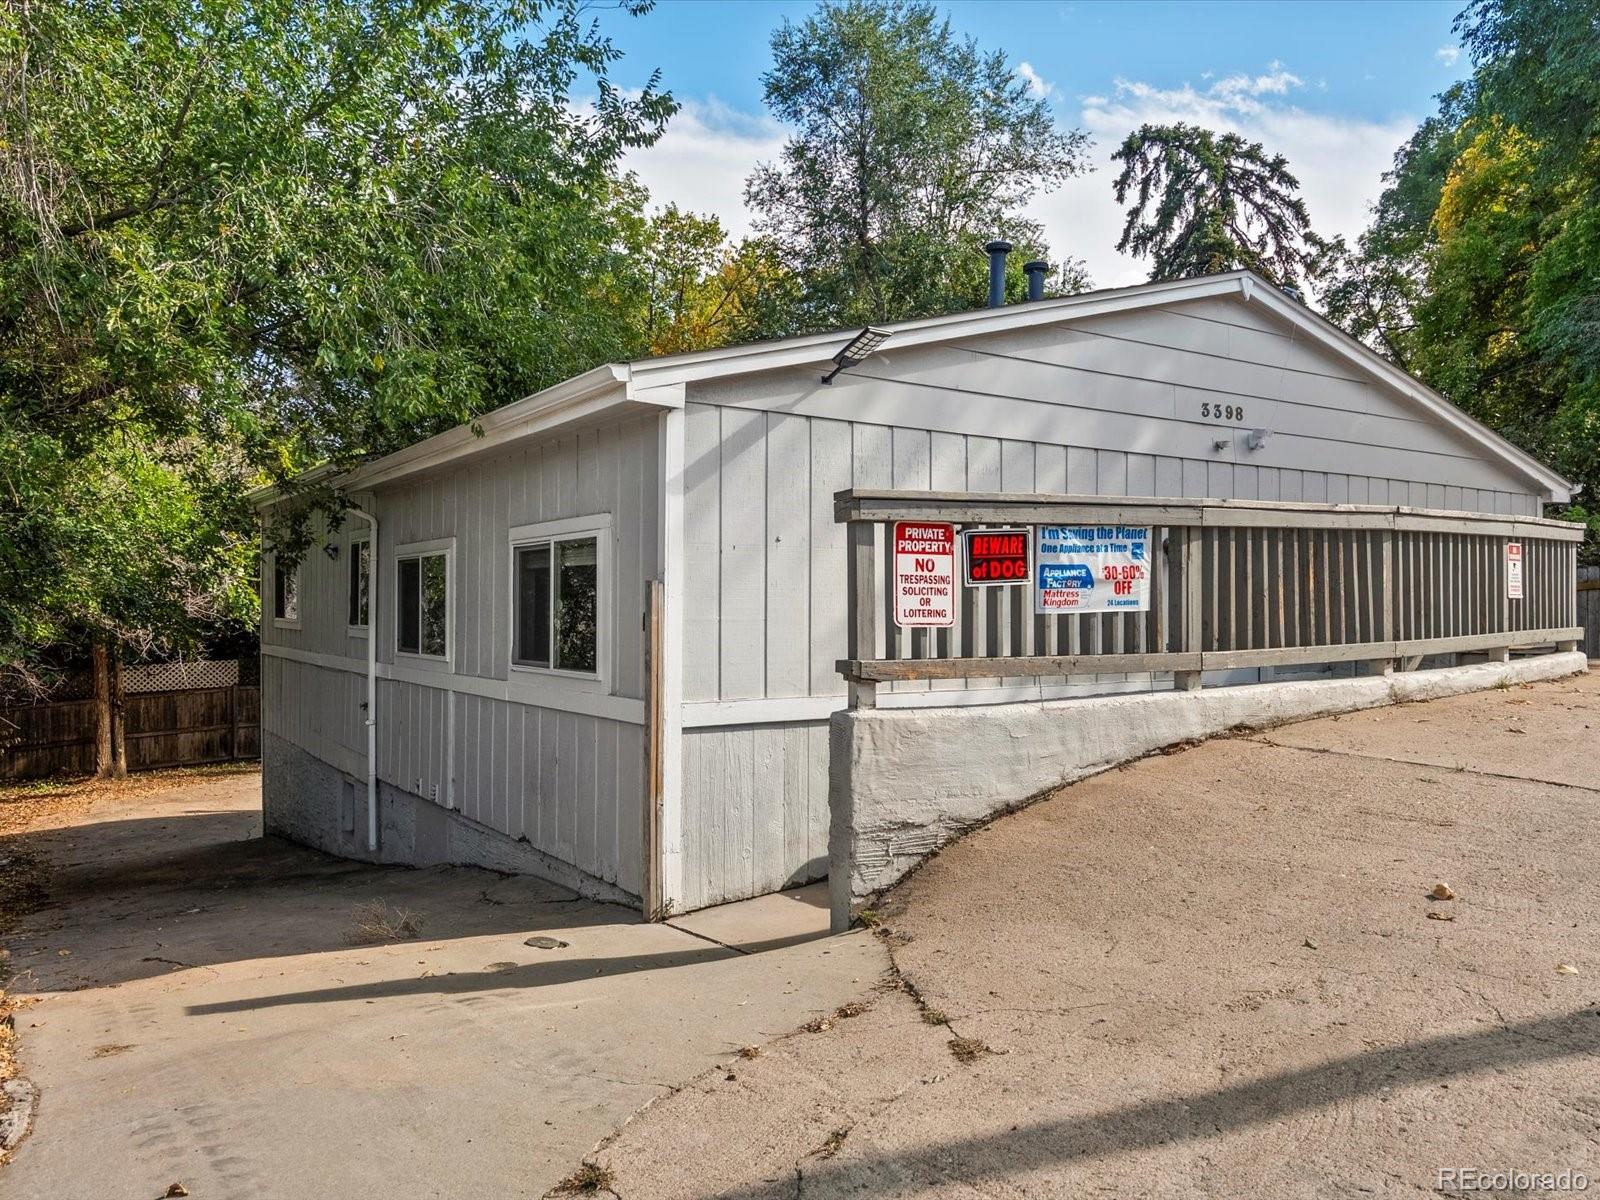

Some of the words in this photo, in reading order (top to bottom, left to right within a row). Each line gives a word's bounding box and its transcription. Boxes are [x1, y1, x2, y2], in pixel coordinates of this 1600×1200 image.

[1201, 402, 1243, 421] 3398
[905, 527, 945, 540] PRIVATE
[1096, 526, 1114, 539] the
[1115, 526, 1148, 539] Planet
[898, 540, 952, 553] PROPERTY
[973, 536, 1025, 554] BEWARE
[1041, 543, 1058, 553] One
[1059, 543, 1095, 554] Appliance
[1104, 544, 1109, 552] a
[1109, 543, 1128, 552] Time
[915, 558, 936, 573] NO
[973, 561, 987, 578] of
[990, 560, 1026, 578] DOG
[1043, 567, 1087, 577] APPLIANCE
[1104, 565, 1145, 580] 30-60%
[899, 574, 951, 585] TRESPASSING
[1047, 578, 1083, 588] FACTORY
[902, 586, 948, 596] SOLICITING
[1114, 580, 1133, 595] OFF
[1043, 590, 1080, 598] Mattress
[919, 597, 931, 607] OR
[1043, 598, 1079, 608] Kingdom
[903, 608, 947, 618] LOITERING
